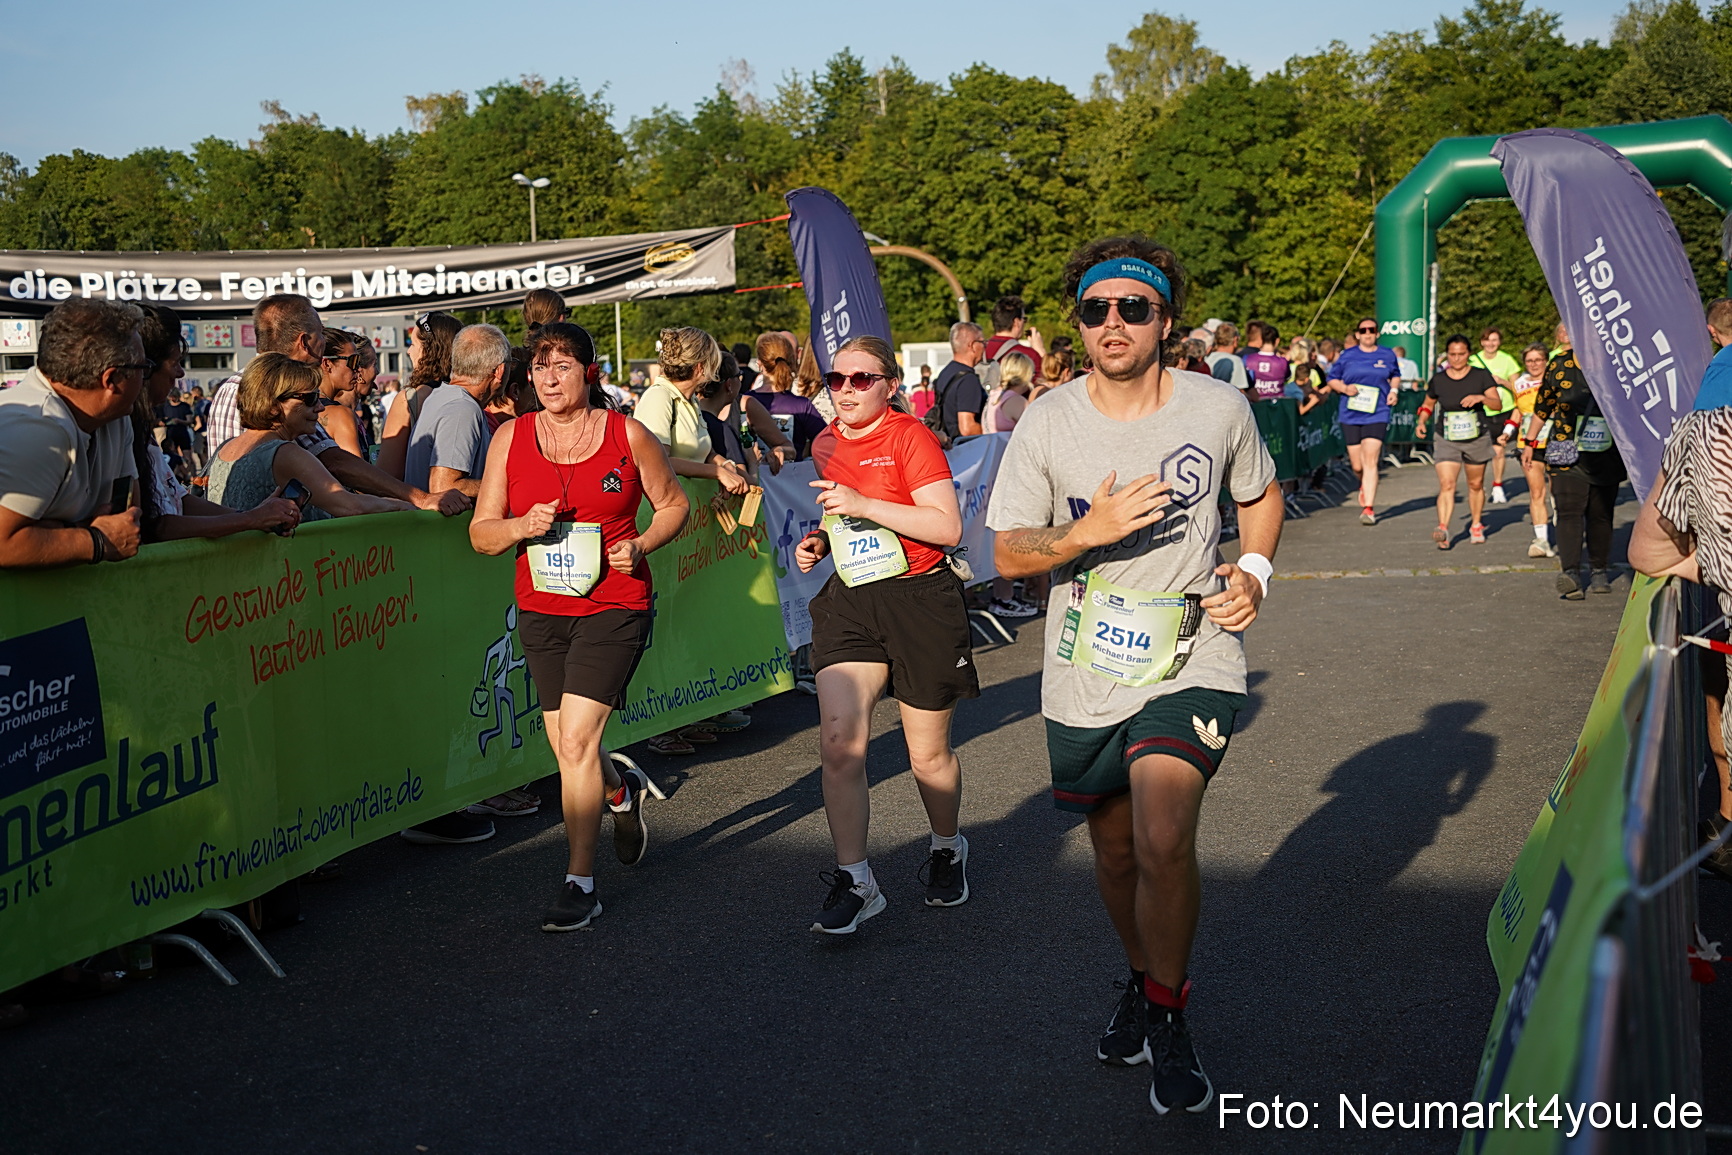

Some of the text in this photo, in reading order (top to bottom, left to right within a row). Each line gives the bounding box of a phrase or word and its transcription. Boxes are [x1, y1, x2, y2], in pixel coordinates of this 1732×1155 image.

[10, 261, 595, 308] die Plätze. Fertig. Miteinander.
[1381, 320, 1412, 335] AOK
[848, 536, 880, 556] 724
[546, 553, 575, 568] 199
[840, 559, 867, 571] Christina
[867, 551, 897, 563] Weininger
[185, 544, 395, 643] Gesunde Firmen
[250, 576, 418, 685] laufen länger!
[1095, 621, 1151, 650] 2514
[1092, 642, 1125, 660] Michael
[1126, 654, 1152, 664] Braun
[131, 768, 424, 907] www.firmenlauf-oberpfalz.de
